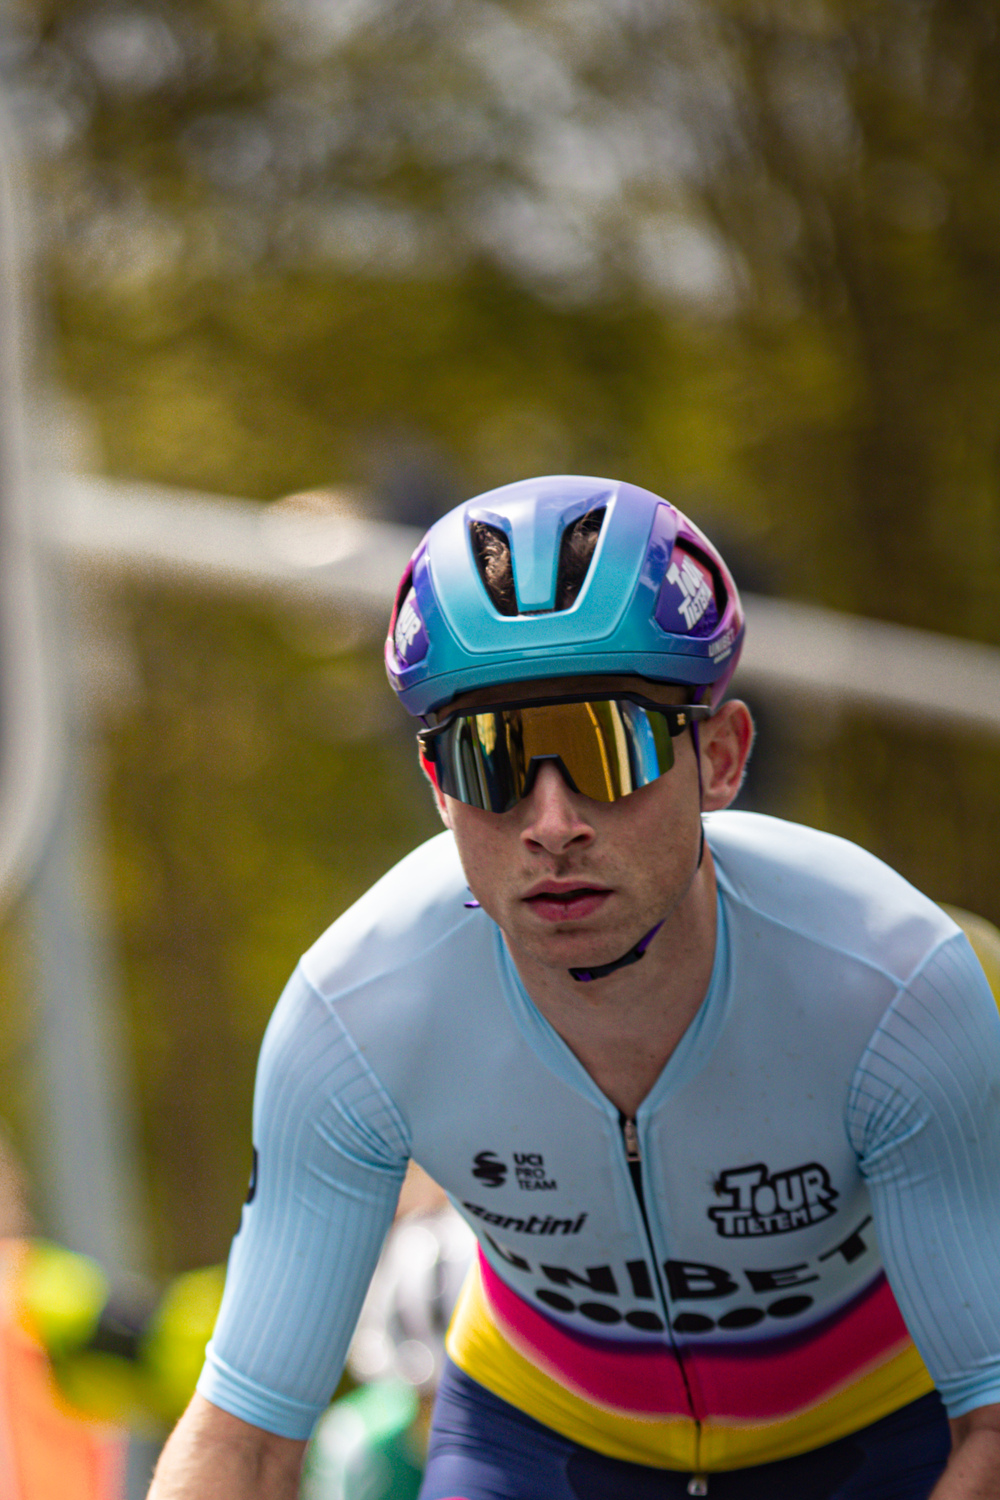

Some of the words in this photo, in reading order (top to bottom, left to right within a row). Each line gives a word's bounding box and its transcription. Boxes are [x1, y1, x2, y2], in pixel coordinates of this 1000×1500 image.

[513, 1153, 544, 1166] UCI
[515, 1167, 545, 1179] PRO
[519, 1179, 557, 1190] TEAM
[725, 1170, 833, 1216] TOUR
[483, 1215, 873, 1302] UNIBET
